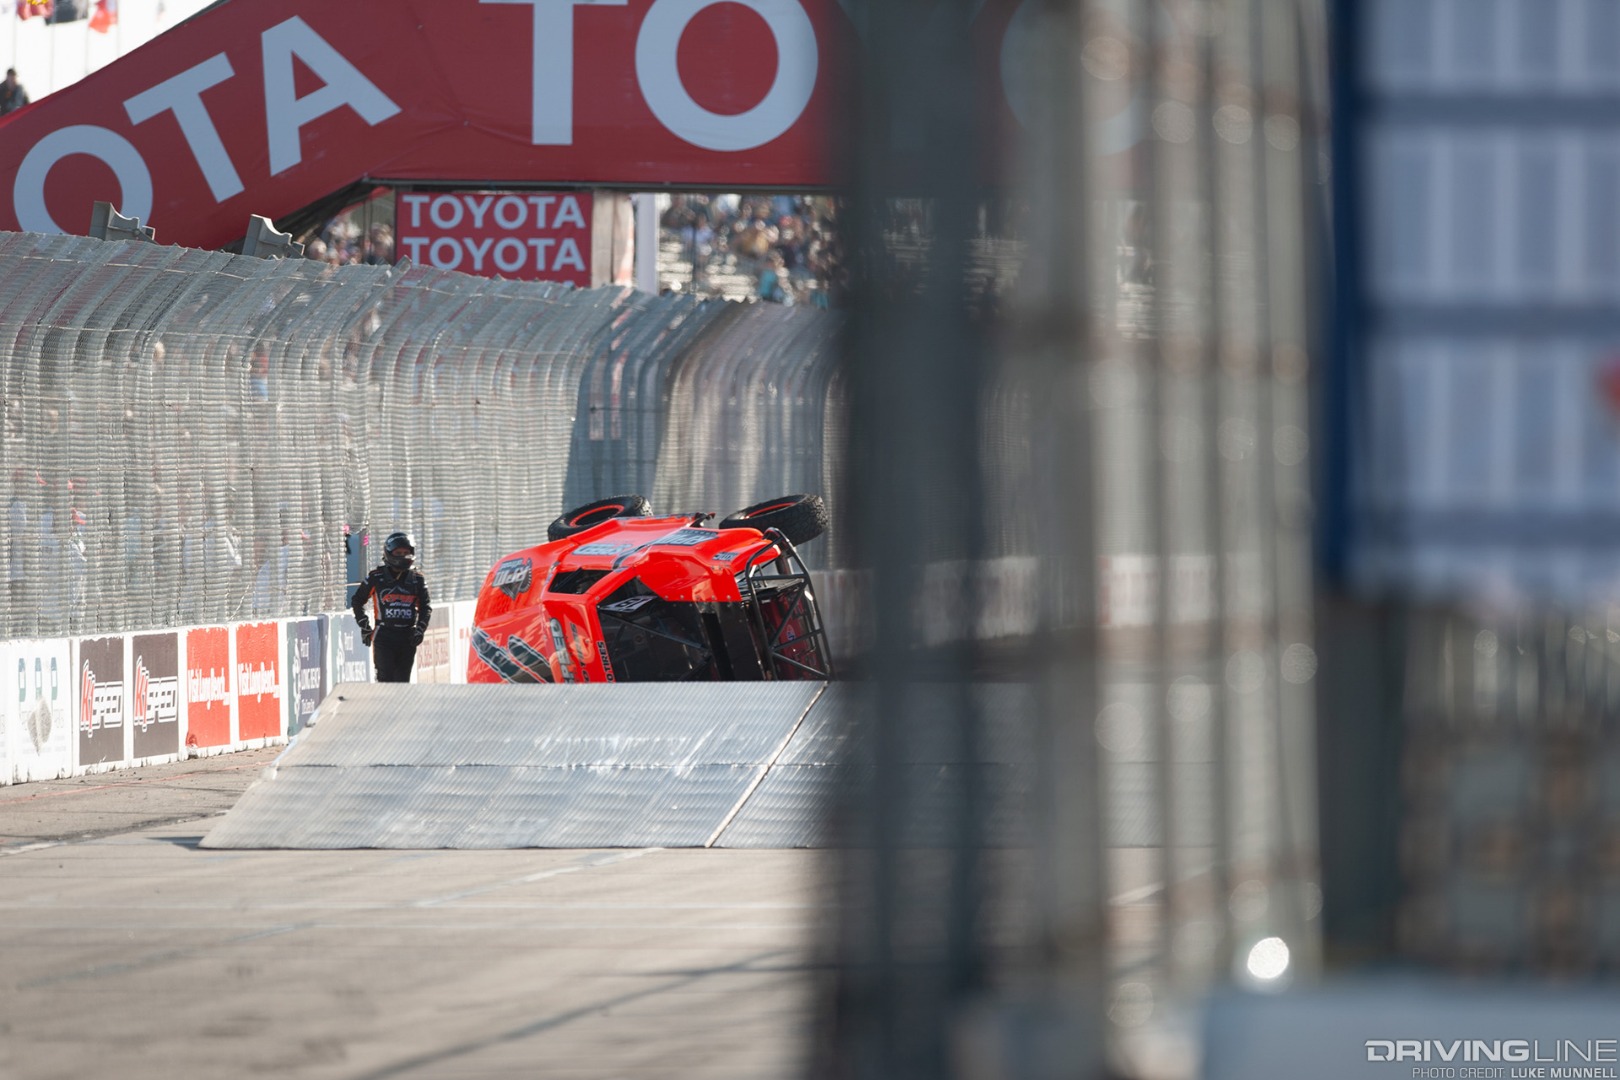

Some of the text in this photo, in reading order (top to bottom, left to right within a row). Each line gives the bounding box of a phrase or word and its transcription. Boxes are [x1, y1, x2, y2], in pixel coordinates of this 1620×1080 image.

[402, 195, 586, 230] TOYOTA
[402, 237, 586, 272] TOYOTA
[596, 640, 613, 673] TIRES
